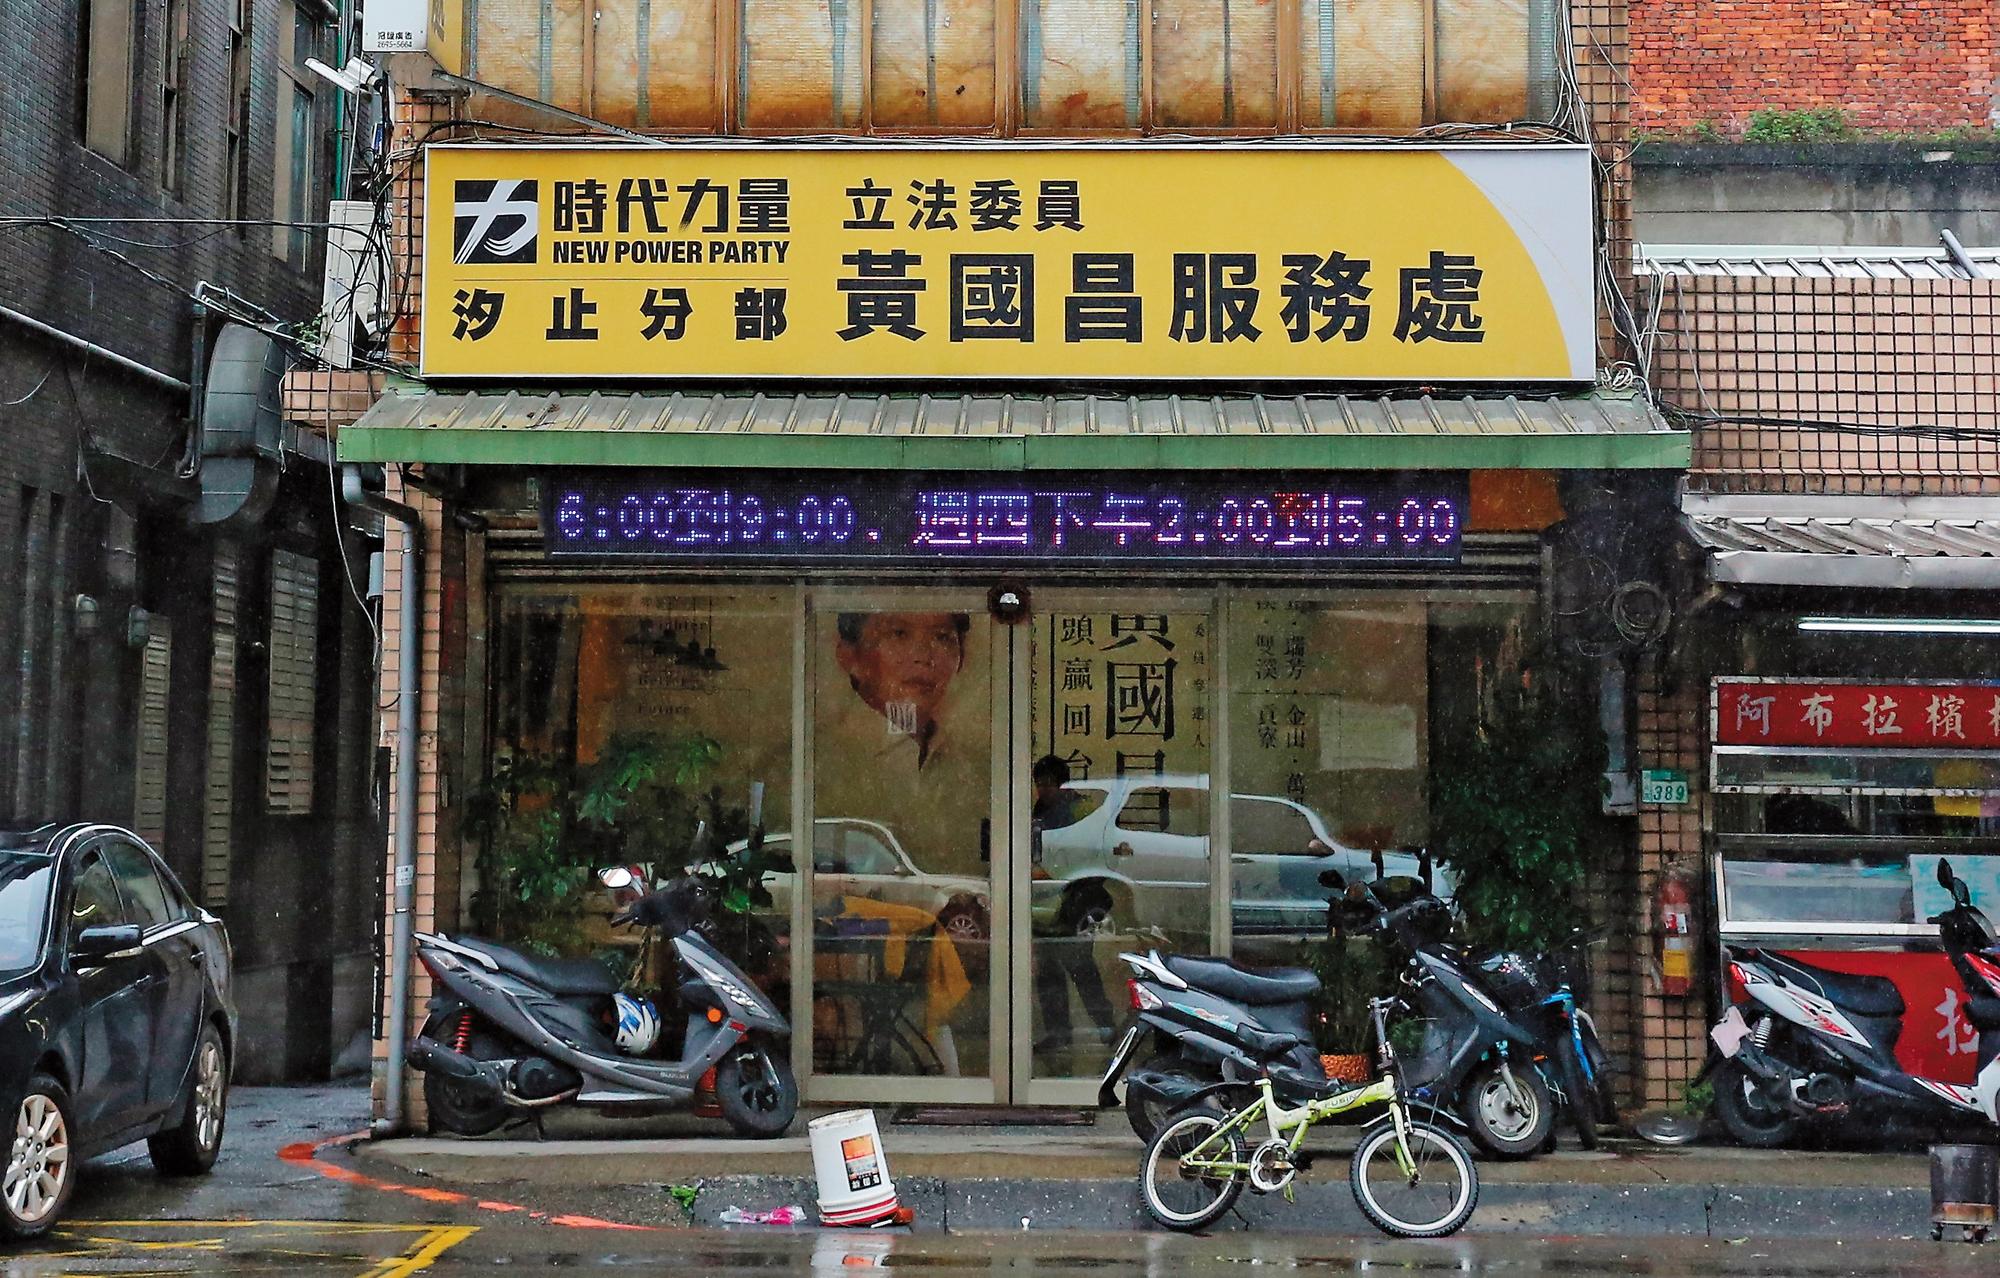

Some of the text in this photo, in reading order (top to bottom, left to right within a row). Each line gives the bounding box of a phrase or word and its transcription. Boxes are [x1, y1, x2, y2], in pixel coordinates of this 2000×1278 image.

[553, 178, 790, 233] 時代力量
[843, 178, 1086, 232] 立法委員
[553, 240, 790, 264] NEW POWER PARTY
[452, 287, 788, 341] 汐止分部
[836, 249, 1486, 344] 黃國昌服務處
[1735, 692, 2000, 740] 阿布拉檳
[1653, 785, 1685, 801] 389
